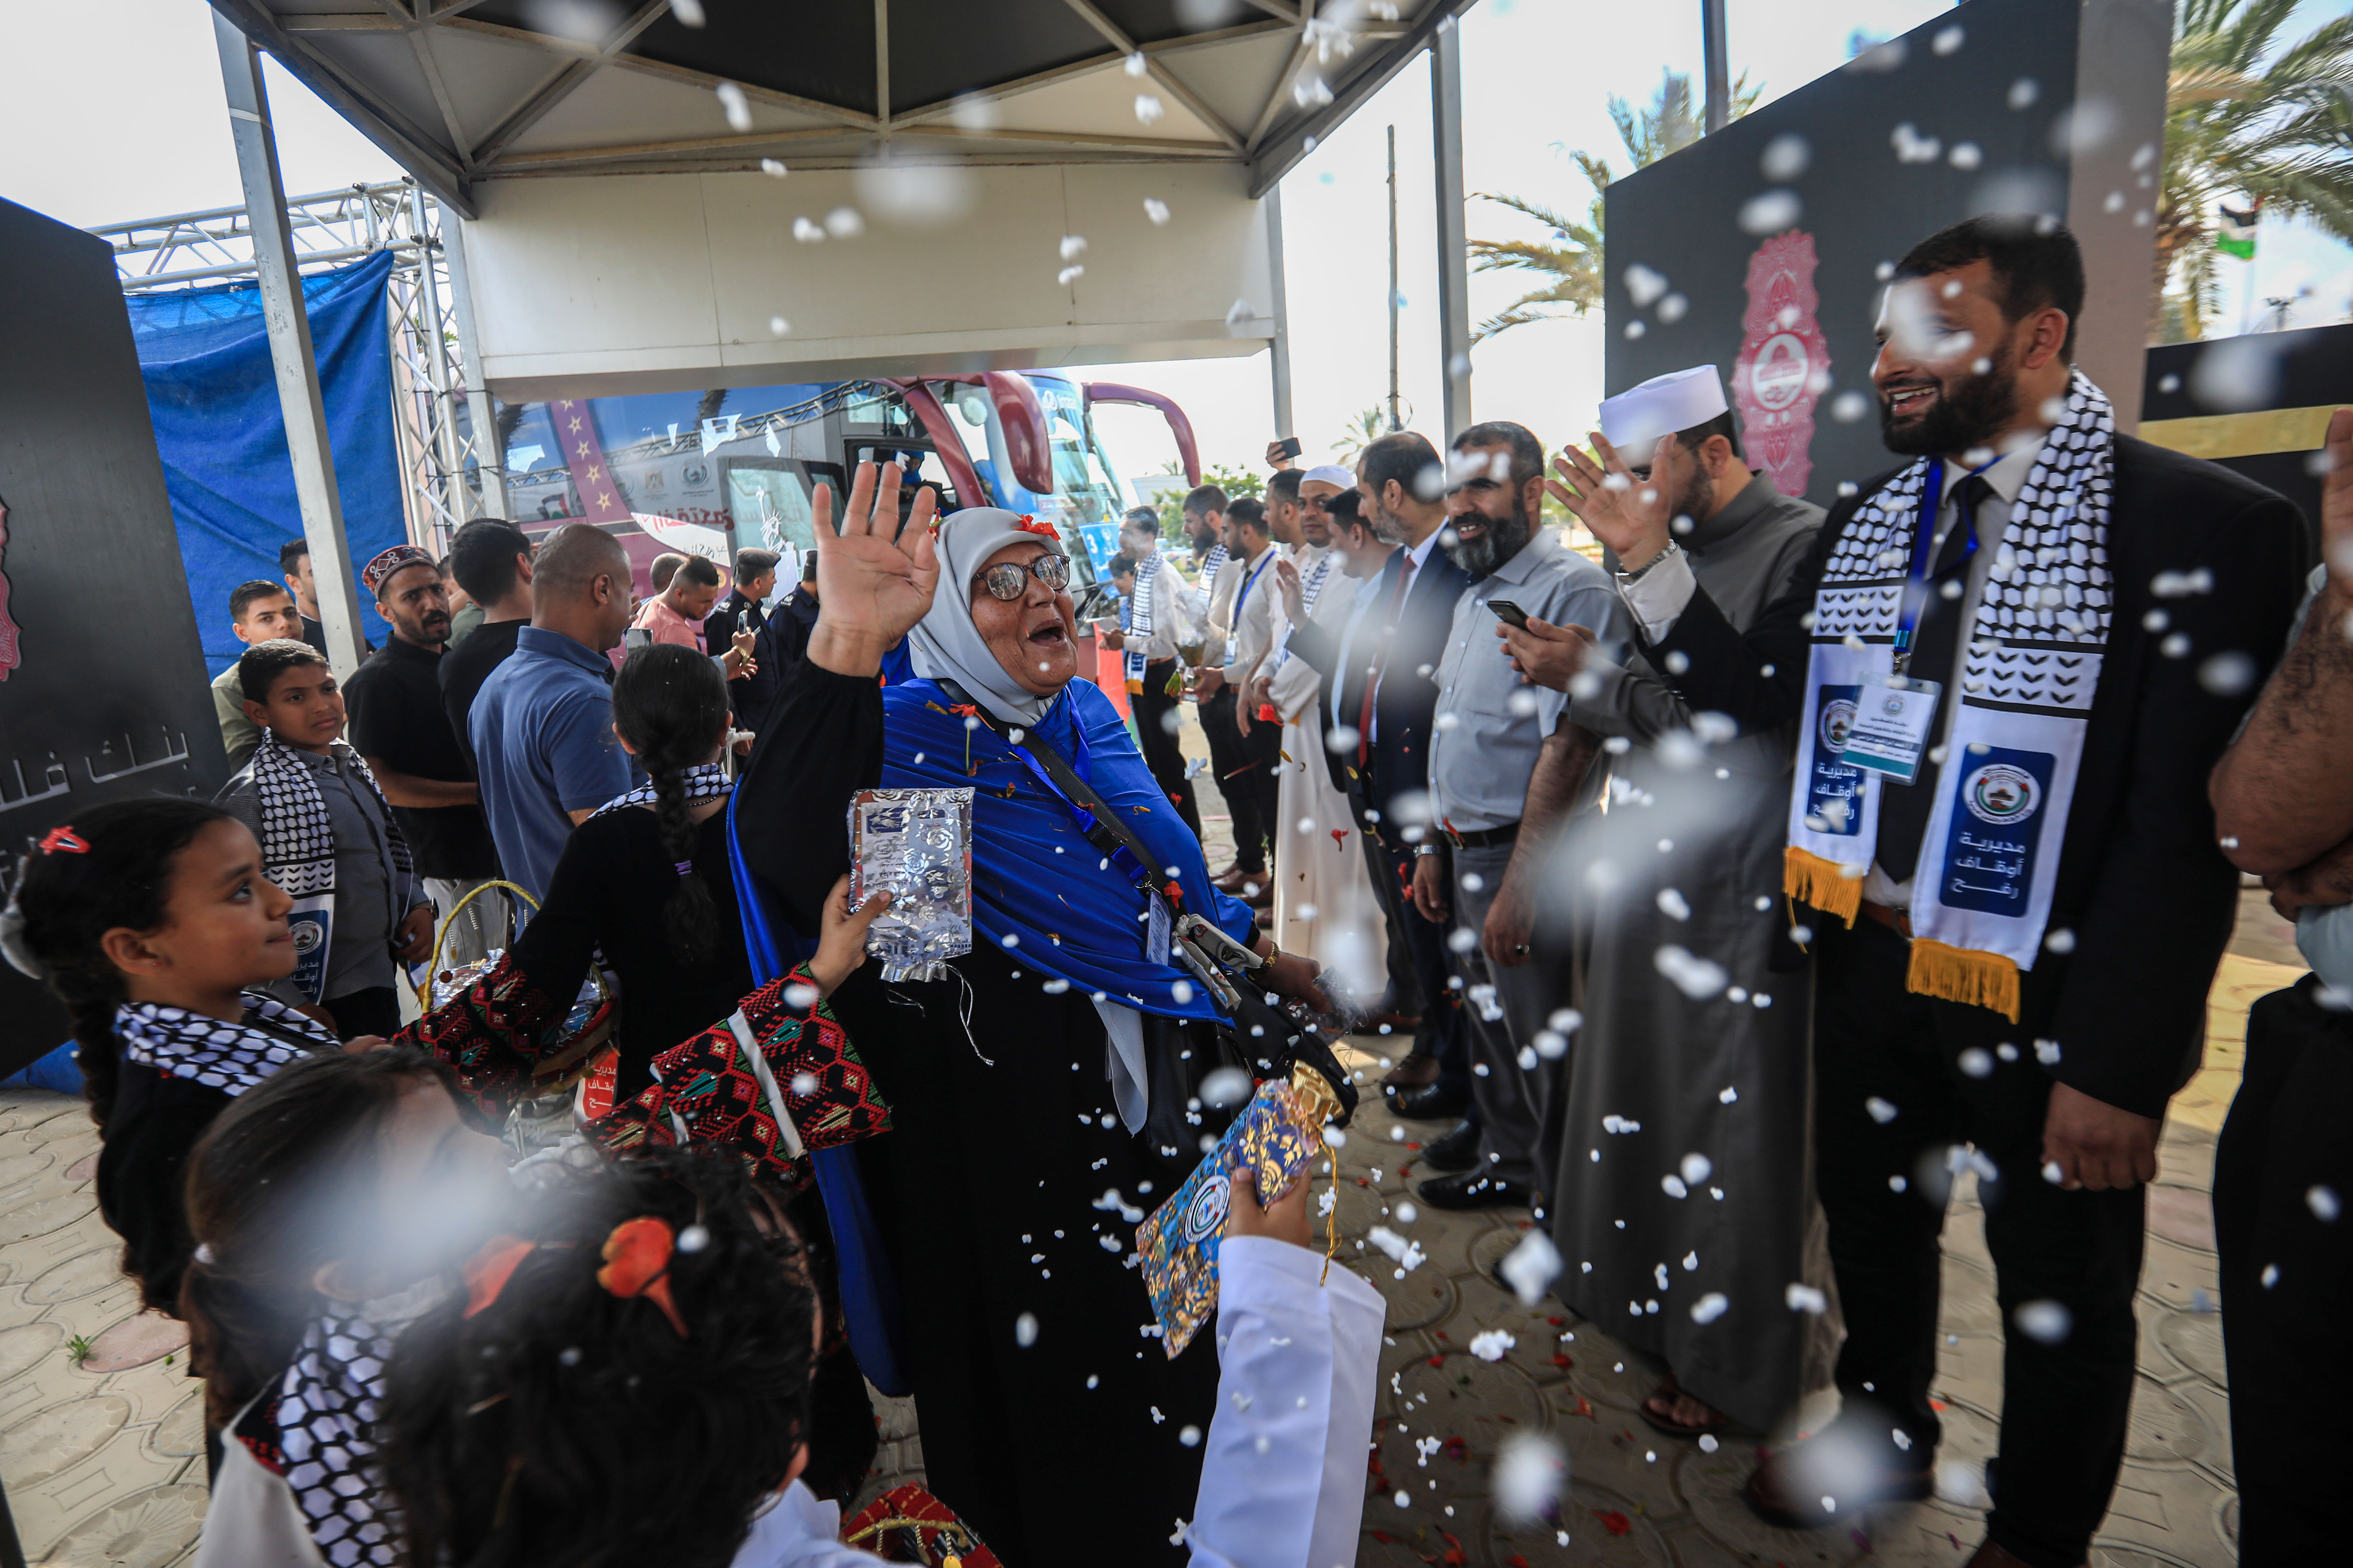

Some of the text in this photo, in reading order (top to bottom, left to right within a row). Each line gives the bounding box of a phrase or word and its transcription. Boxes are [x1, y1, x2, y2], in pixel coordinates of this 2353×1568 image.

[84, 724, 189, 784] بنك
[1816, 762, 1857, 778] مديرية
[1814, 780, 1857, 800] أوقاف
[1959, 831, 2026, 854] مديرية
[1954, 855, 2025, 878] أوقاف
[1950, 878, 2019, 899] رفح
